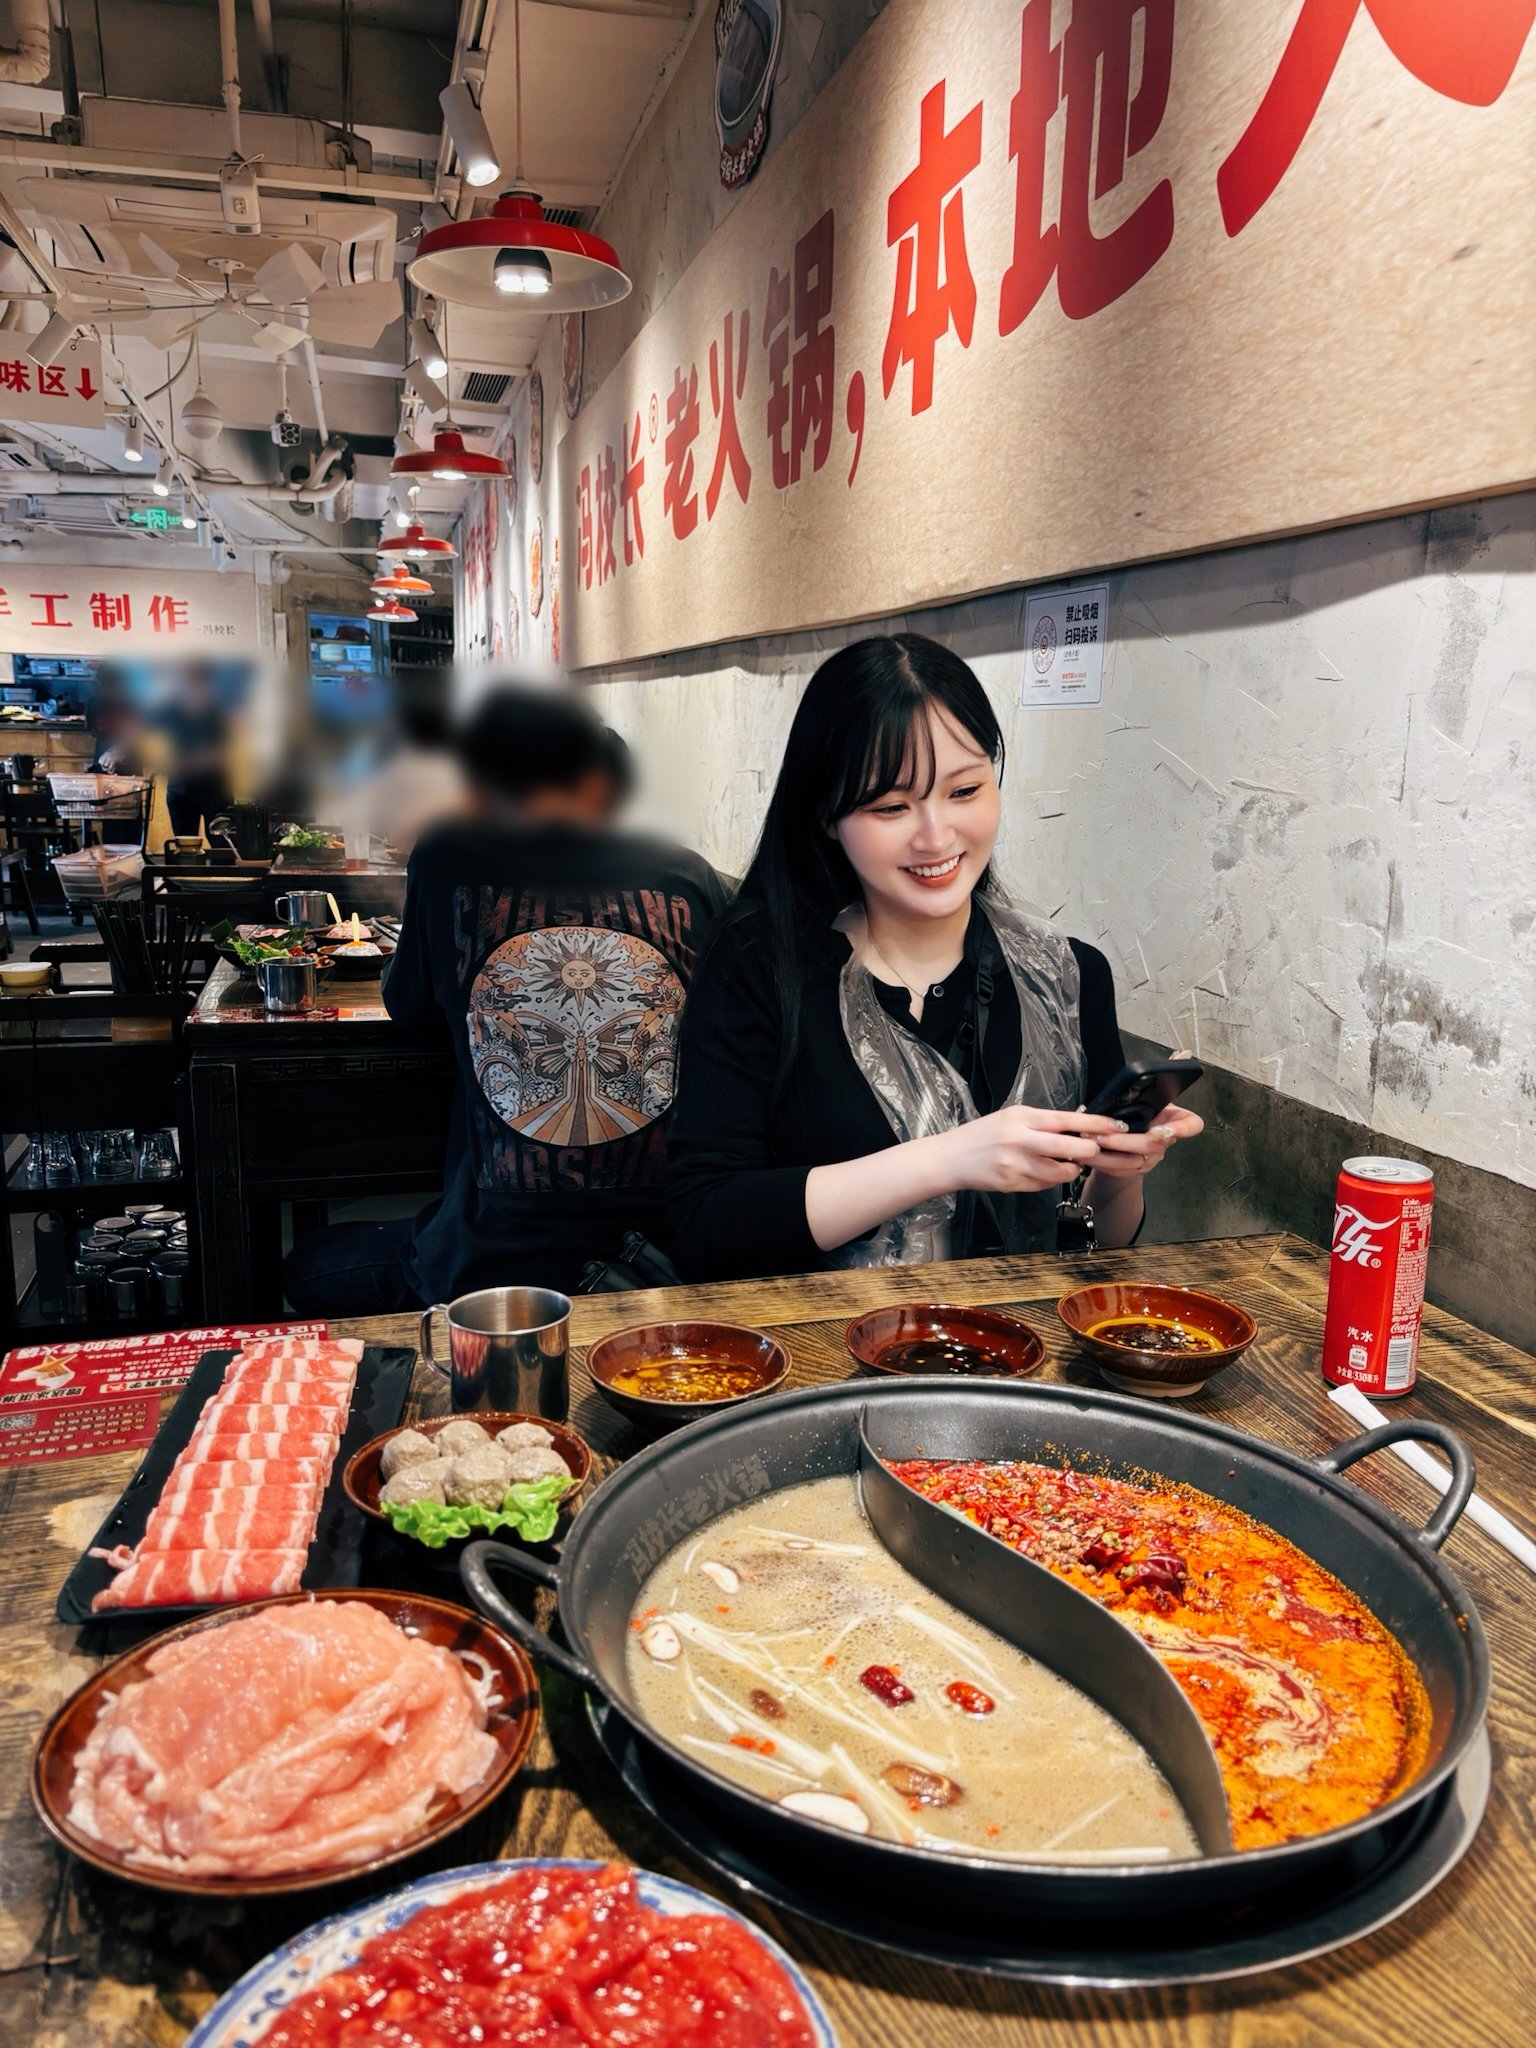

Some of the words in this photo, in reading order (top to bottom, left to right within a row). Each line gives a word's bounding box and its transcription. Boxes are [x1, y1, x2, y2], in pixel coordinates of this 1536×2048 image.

[0, 360, 69, 397] 味区
[0, 588, 189, 633] 工制作
[1066, 603, 1099, 623] 禁止吸烟
[1065, 626, 1098, 646] 扫码投诉
[1347, 1326, 1374, 1344] 汽水
